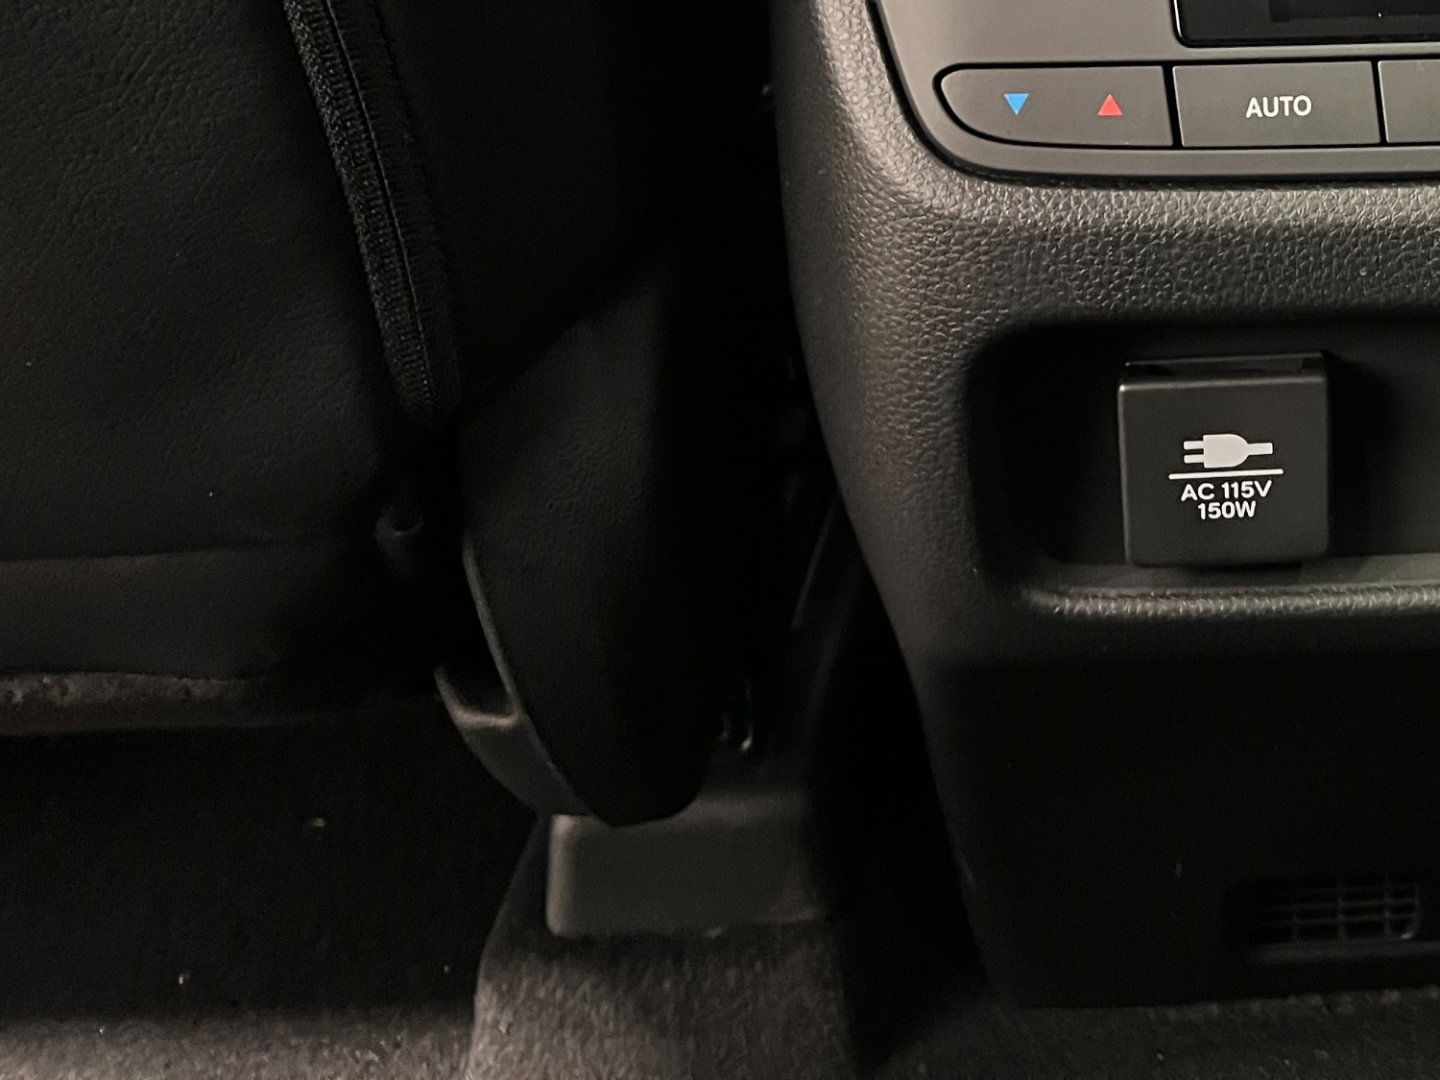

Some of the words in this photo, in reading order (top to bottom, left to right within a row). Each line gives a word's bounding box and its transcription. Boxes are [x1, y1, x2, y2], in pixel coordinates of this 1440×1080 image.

[1245, 94, 1312, 118] AUTO
[1181, 482, 1216, 502] AC
[1221, 480, 1273, 499] 115V
[1197, 500, 1257, 520] 150W
